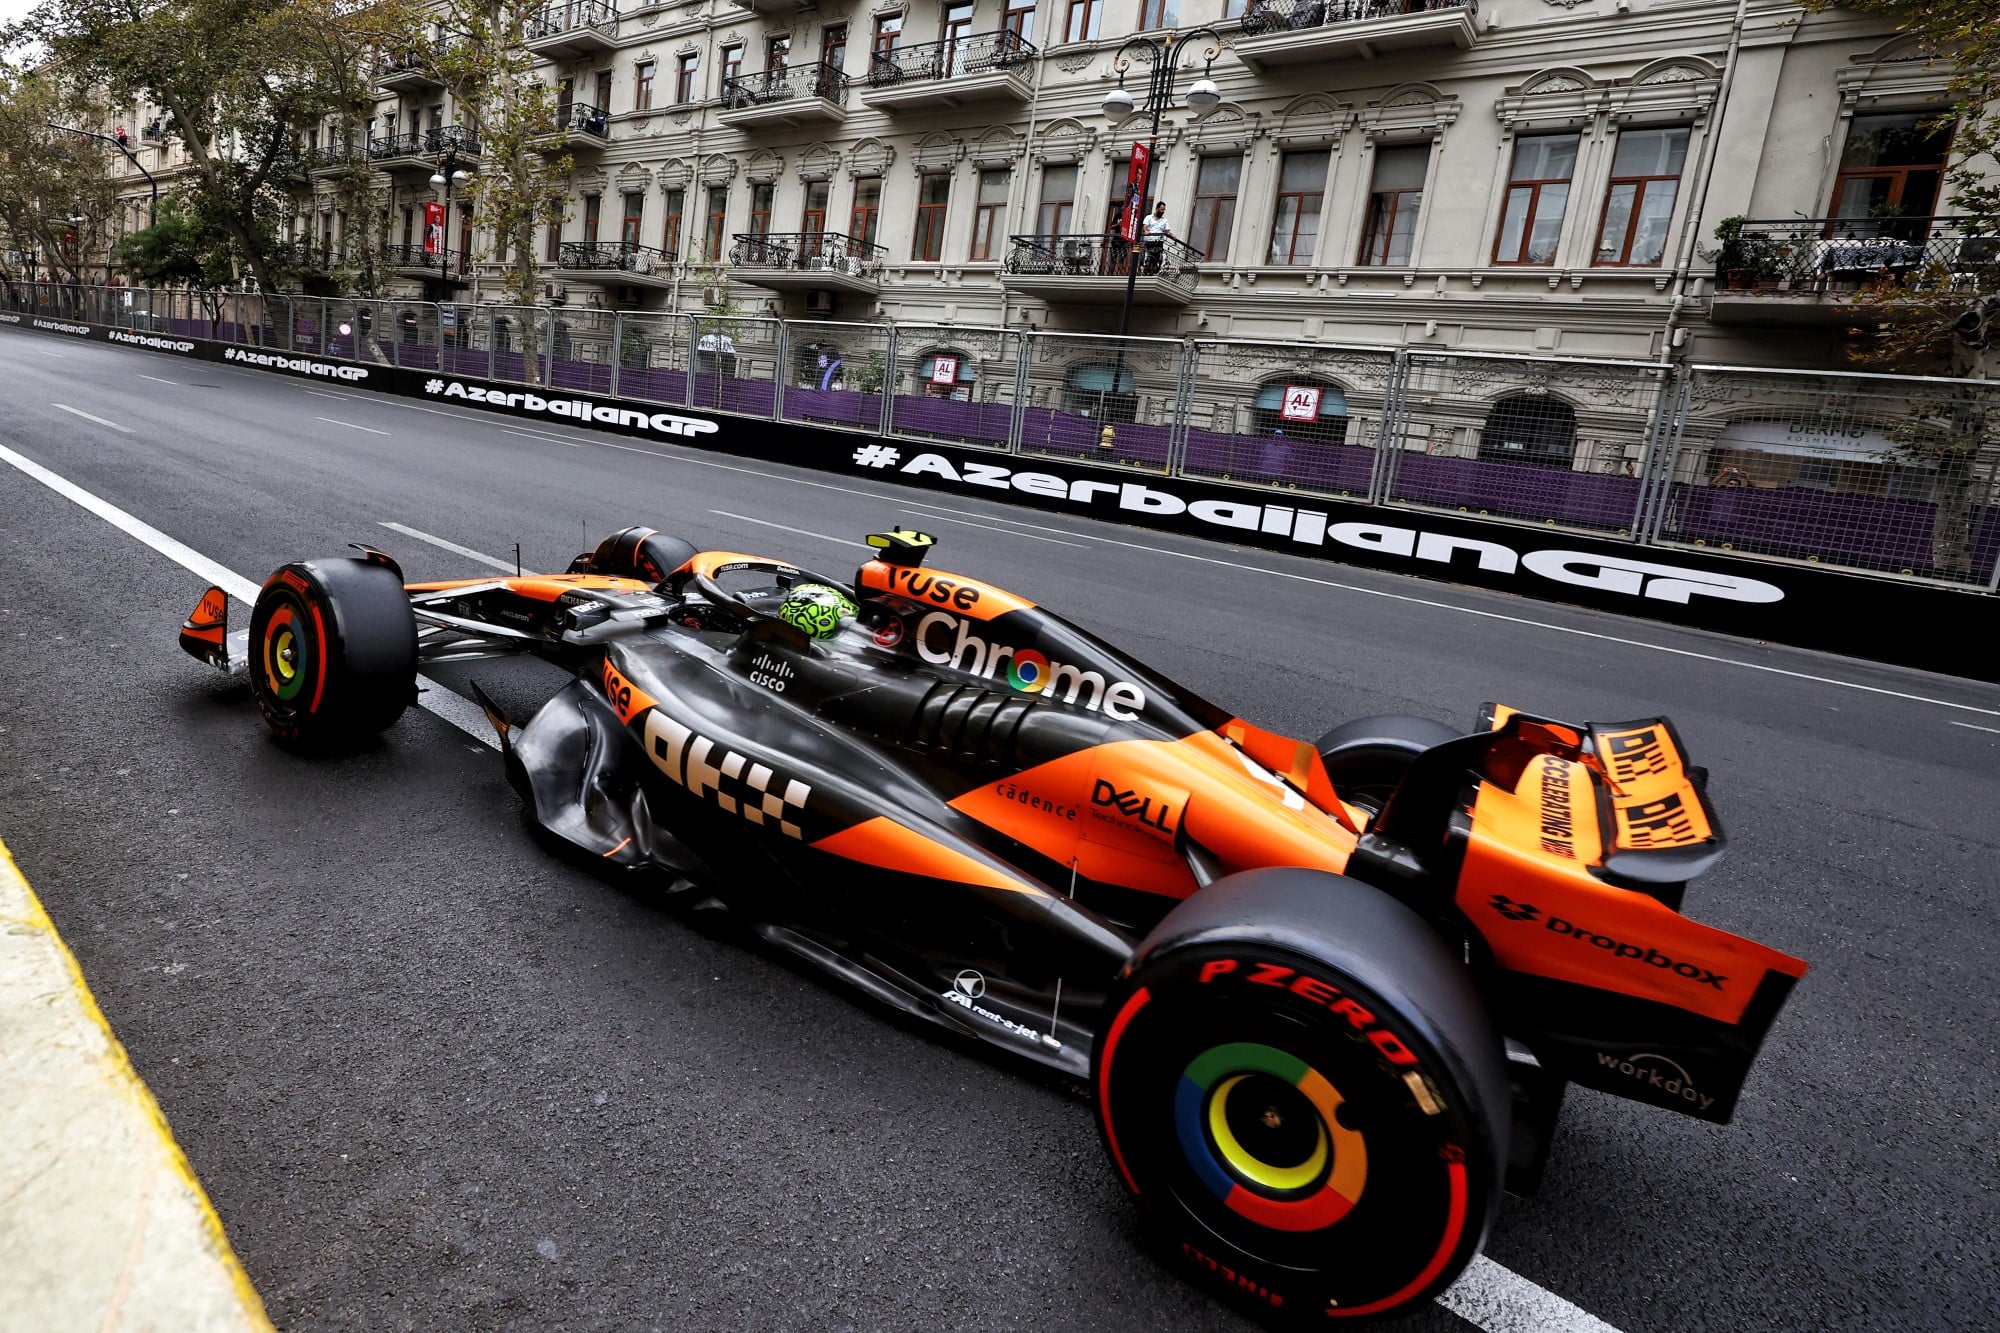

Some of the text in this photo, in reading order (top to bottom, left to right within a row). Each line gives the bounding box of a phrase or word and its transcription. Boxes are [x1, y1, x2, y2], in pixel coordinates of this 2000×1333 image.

[33, 318, 91, 335] #AzerbaijanGP
[108, 330, 195, 353] #AzerbaijanGP
[224, 347, 369, 381] #AzerbaijanGP
[938, 362, 951, 374] AL
[424, 378, 719, 437] #AzerbaijanGP
[1291, 393, 1312, 407] AL
[1786, 435, 1862, 448] KOSMETIKA
[851, 445, 1785, 604] #AzerbaijanGP
[916, 611, 1146, 722] Chrome
[1091, 778, 1173, 834] DELL
[1546, 916, 1729, 991] Dropbox
[1199, 959, 1420, 1065] P ZERO
[1597, 1053, 1716, 1110] workday
